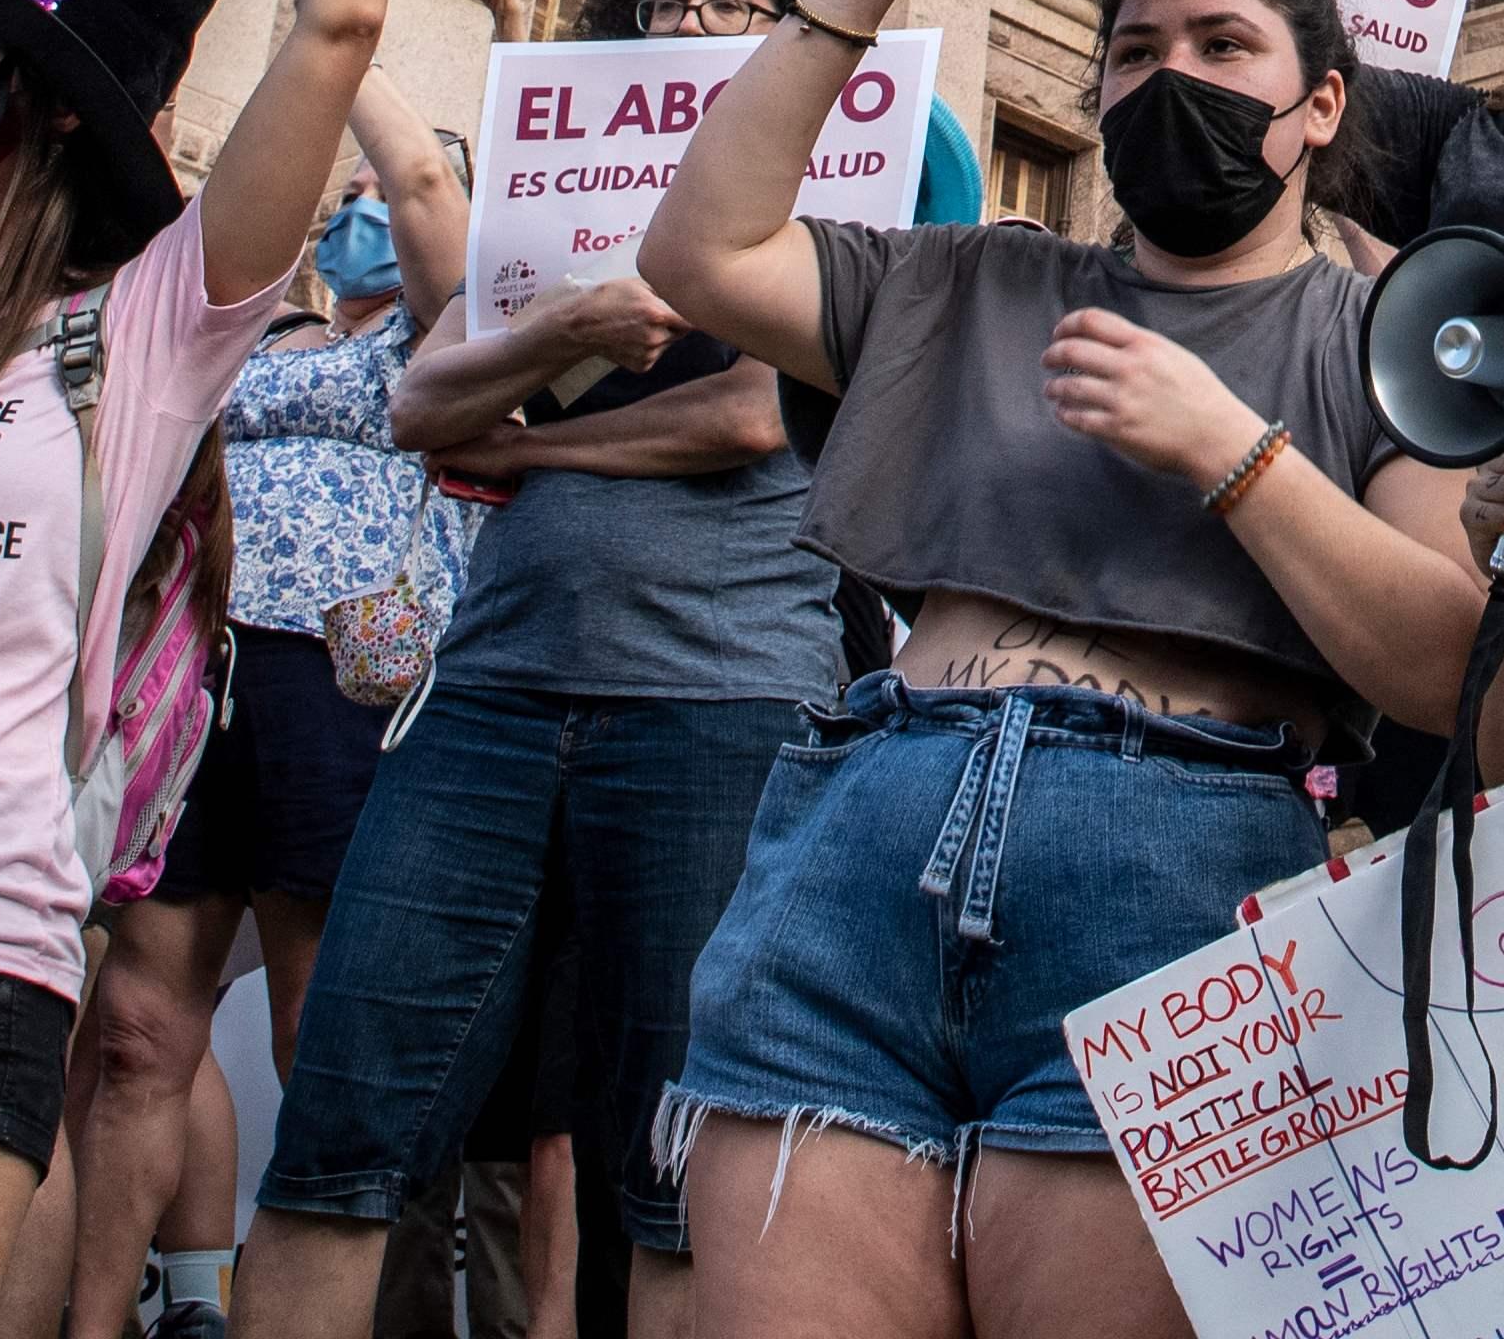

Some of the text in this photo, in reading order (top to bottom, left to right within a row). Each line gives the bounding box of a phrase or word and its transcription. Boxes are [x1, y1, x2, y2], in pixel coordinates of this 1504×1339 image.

[1348, 14, 1428, 54] SALUD
[515, 70, 896, 141] EL ABO
[507, 151, 887, 199] ES CUIDAD ALUD
[1082, 939, 1299, 1079] MY BODY
[1101, 987, 1344, 1120] IS NOT YOUR
[1120, 1064, 1334, 1171] POLITICAL
[1196, 1145, 1418, 1270] WOMENS
[1261, 1202, 1404, 1278] RIGHTS
